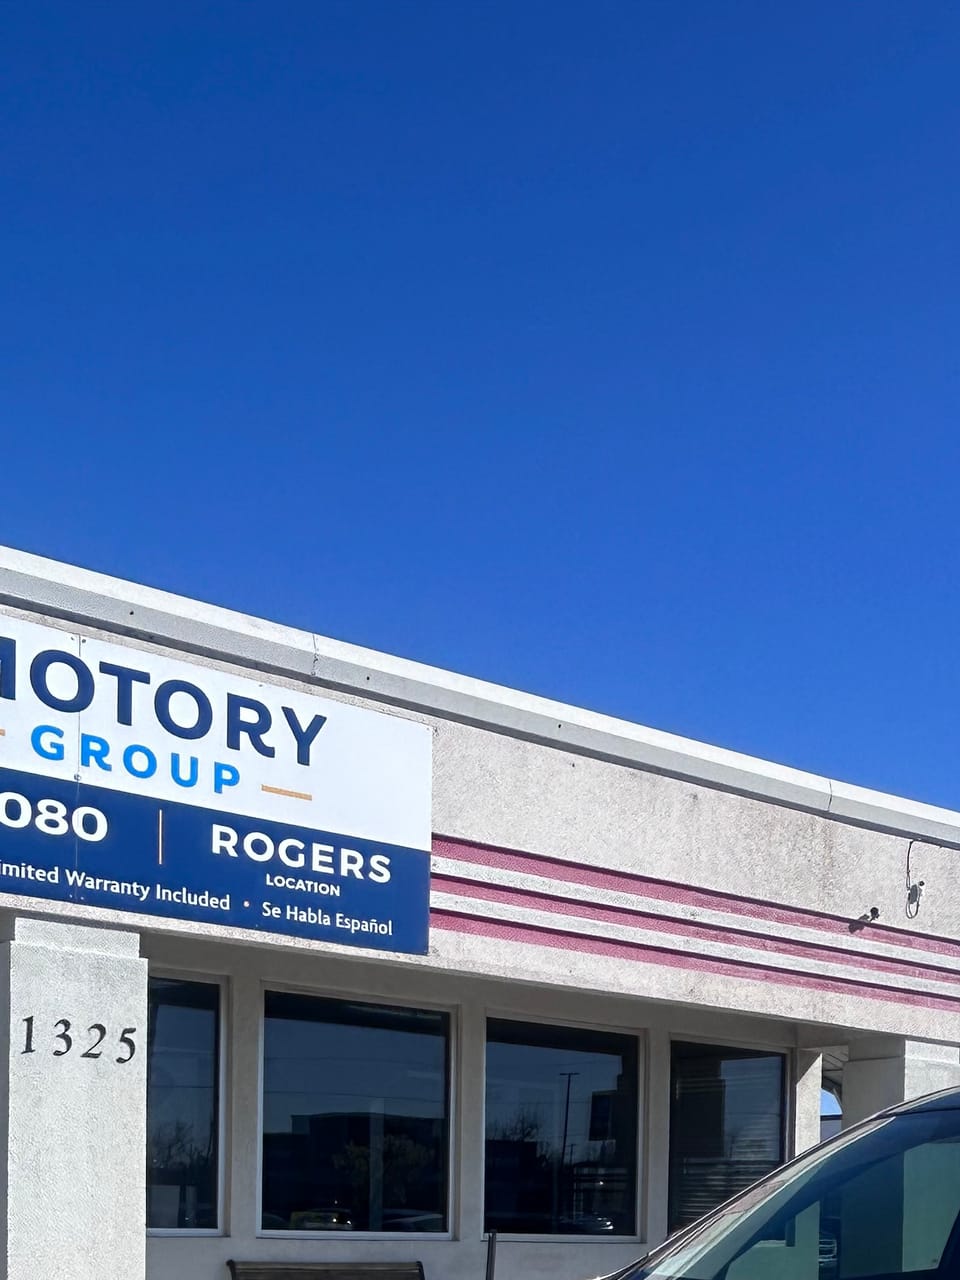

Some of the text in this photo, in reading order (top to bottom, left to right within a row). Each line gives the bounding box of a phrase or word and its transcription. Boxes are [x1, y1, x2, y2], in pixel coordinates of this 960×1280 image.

[0, 636, 327, 766] OTORY
[31, 724, 240, 794] GROUP
[0, 791, 108, 842] 080
[211, 823, 392, 883] ROGERS
[0, 860, 230, 910] mited Warranty Included
[266, 873, 340, 897] LOCATION
[262, 901, 393, 936] Se Habla Español
[20, 1015, 137, 1064] 1325
